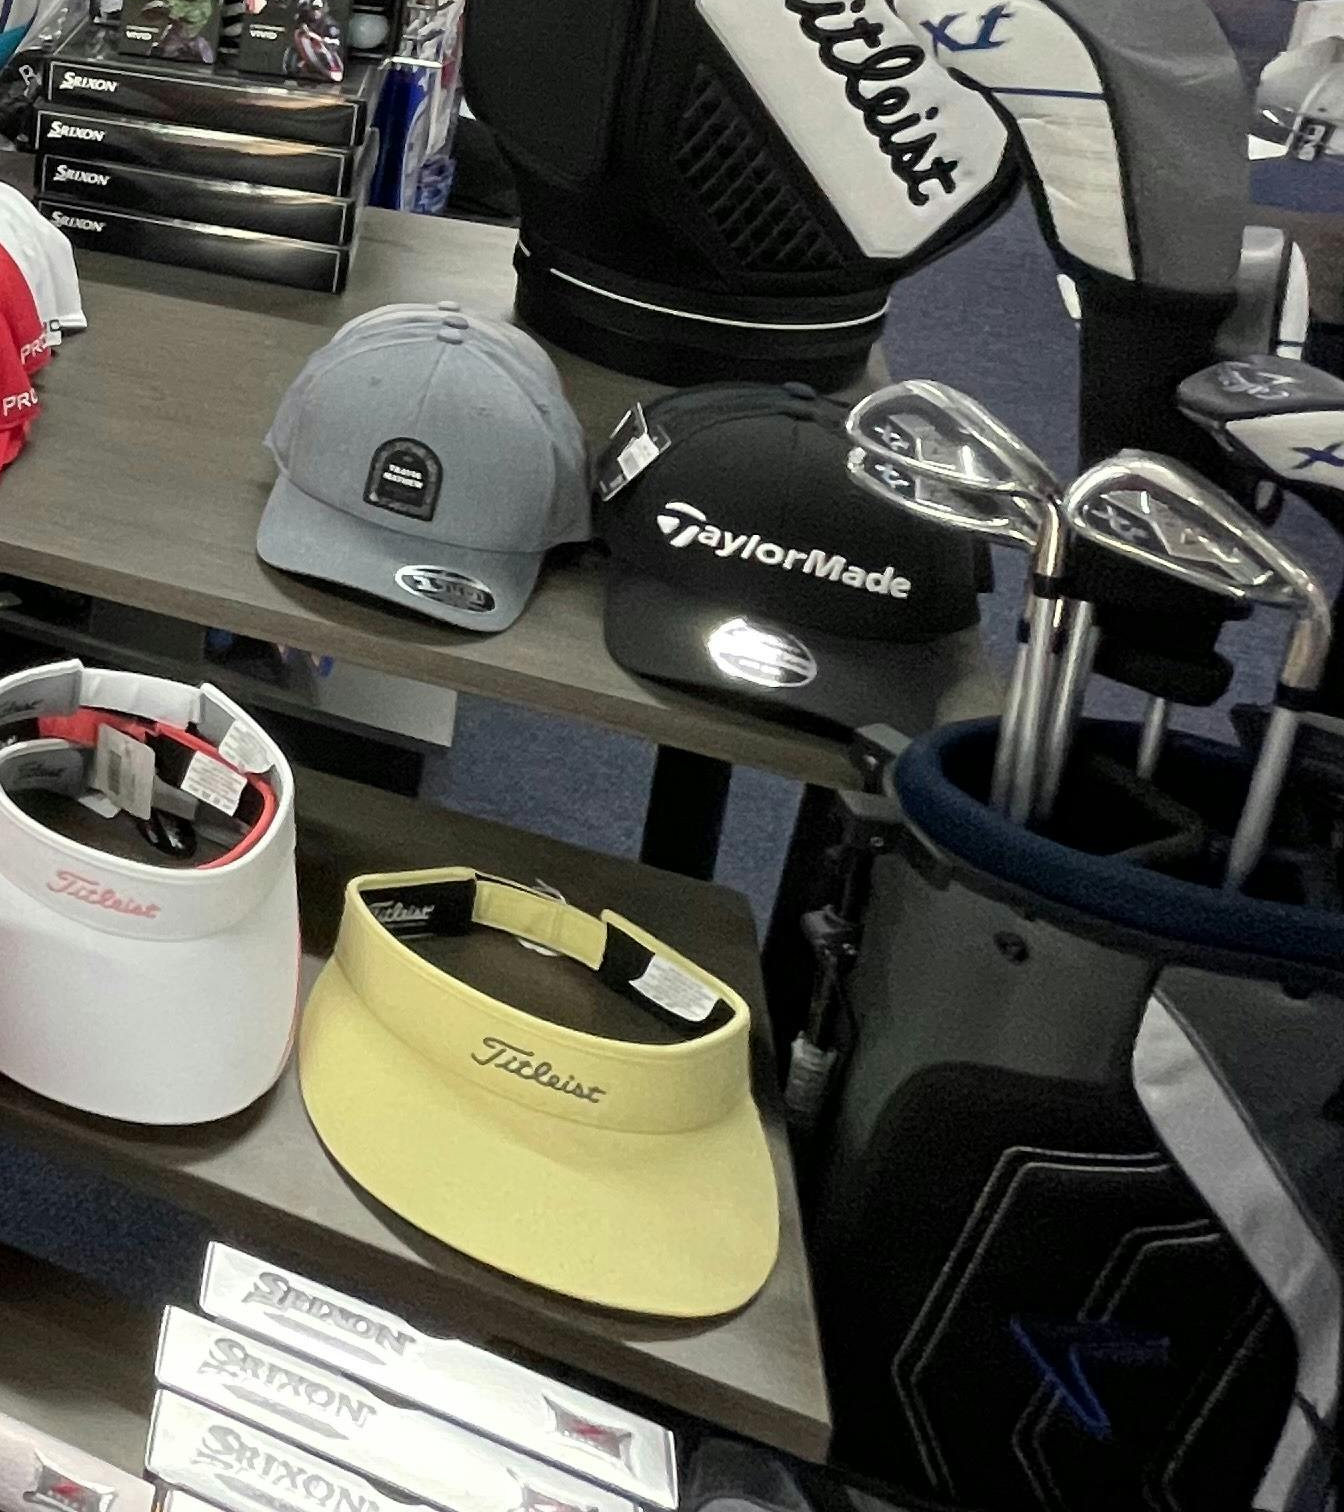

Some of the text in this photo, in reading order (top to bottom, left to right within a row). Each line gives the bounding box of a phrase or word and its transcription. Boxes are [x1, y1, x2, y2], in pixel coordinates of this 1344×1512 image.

[59, 72, 117, 93] SRIXON
[47, 120, 105, 142] SRIXON
[54, 164, 110, 186] SRIXON
[51, 210, 106, 232] SRIXON
[657, 501, 911, 600] TaylorMade
[47, 869, 162, 920] Titleist
[470, 1036, 607, 1106] Titleist
[242, 1271, 417, 1358] SRIXON
[197, 1336, 377, 1428] SRIXON
[191, 1423, 381, 1512] SRIXON
